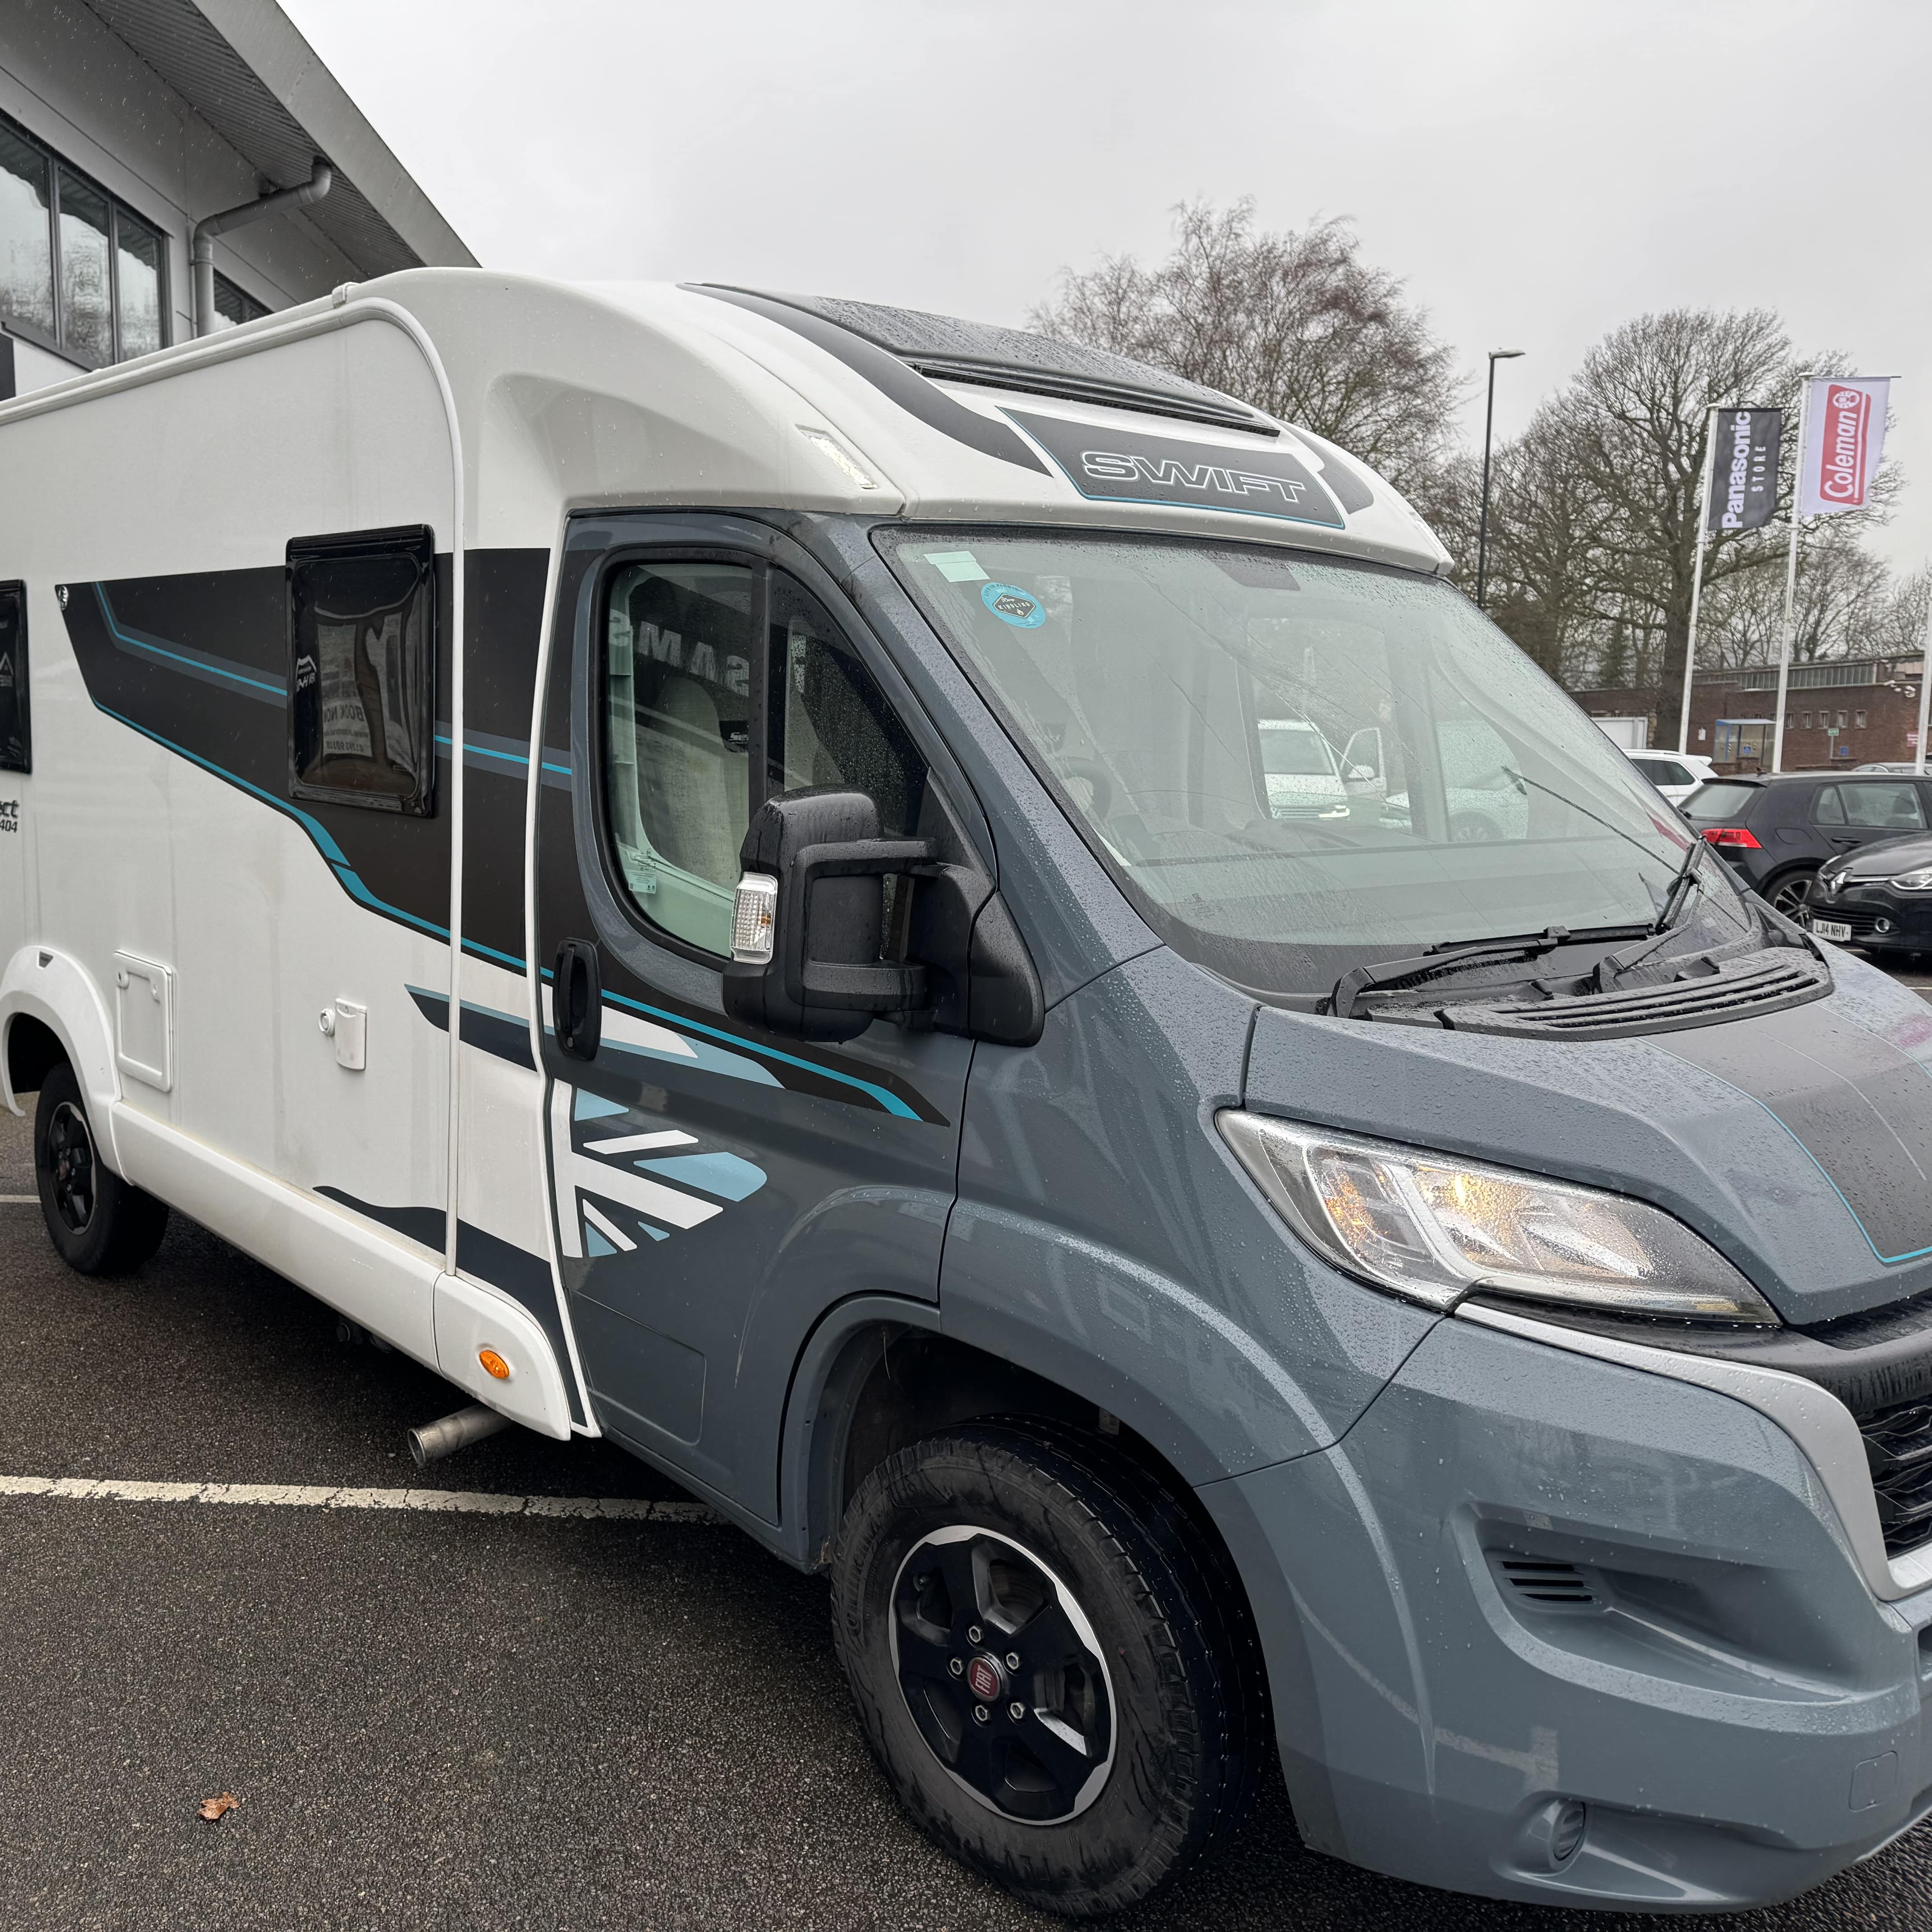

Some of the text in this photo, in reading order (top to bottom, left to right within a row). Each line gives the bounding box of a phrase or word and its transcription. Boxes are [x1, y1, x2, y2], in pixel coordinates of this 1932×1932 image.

[1722, 411, 1751, 528] Panasonic
[1751, 446, 1766, 492] STORE
[1824, 411, 1858, 497] Coleman
[1081, 451, 1306, 503] SWIFT
[998, 602, 1030, 610] KINDLING
[0, 820, 18, 833] 404
[1816, 921, 1846, 938] LJ14 NHV
[975, 1665, 992, 1694] FIAT
